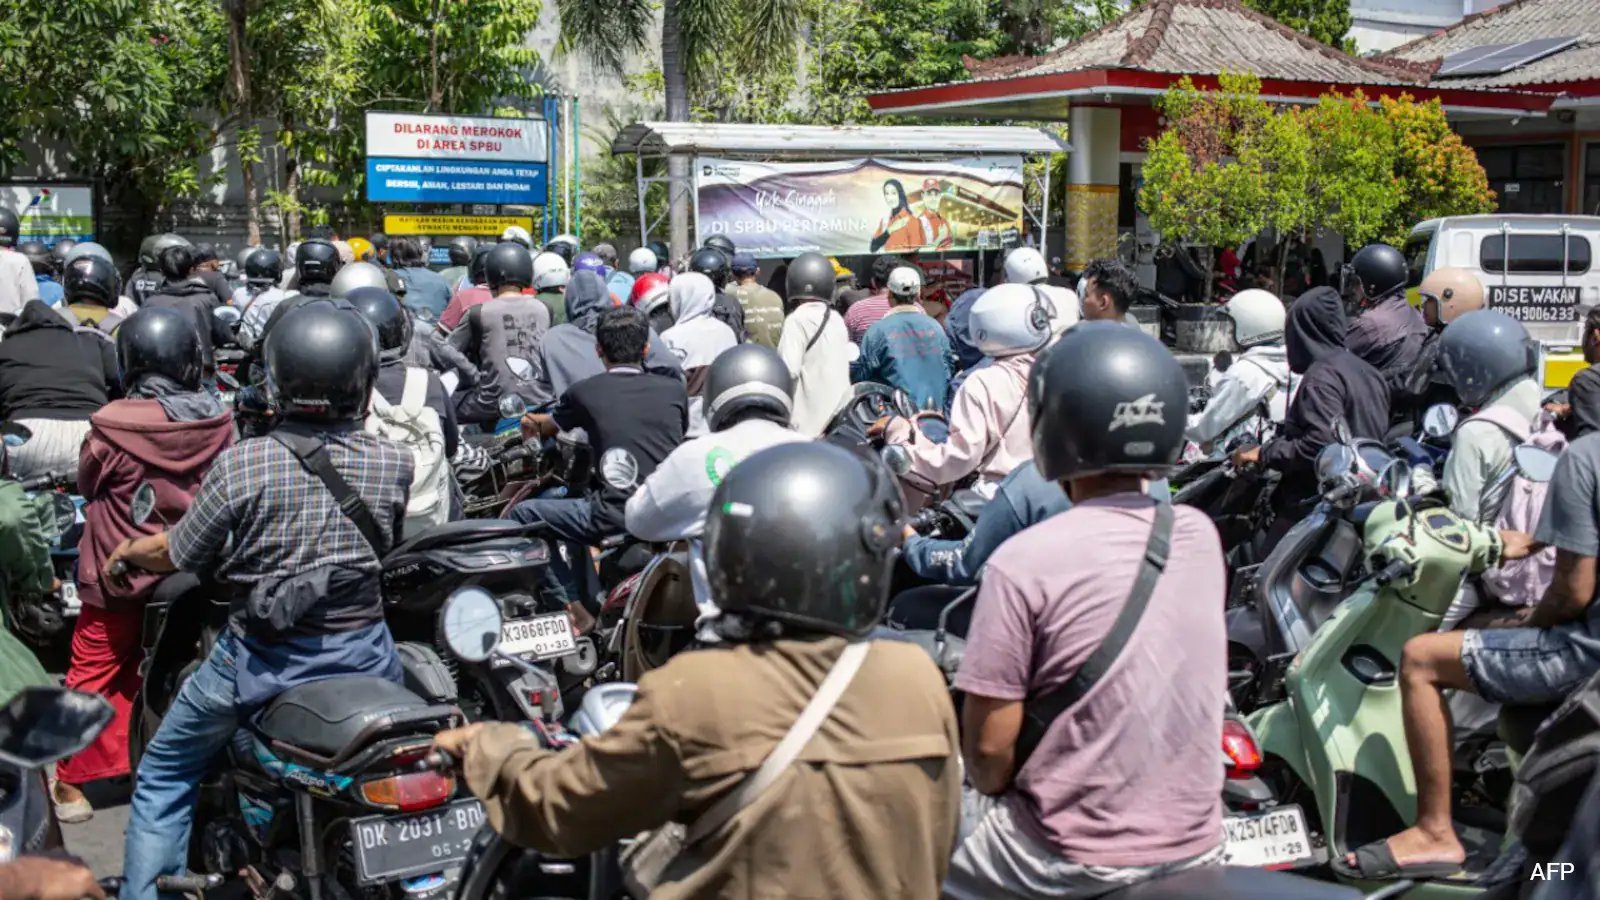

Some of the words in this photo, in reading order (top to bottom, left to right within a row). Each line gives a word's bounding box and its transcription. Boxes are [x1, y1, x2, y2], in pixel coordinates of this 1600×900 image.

[394, 123, 458, 136] DILARANG
[462, 126, 522, 139] MEROKOK
[417, 140, 430, 150] DI
[433, 140, 465, 151] AREA
[470, 141, 502, 152] SPBU
[436, 165, 490, 175] LINGKUNGAN
[492, 167, 514, 177] ANDA
[516, 169, 540, 178] TETAP
[451, 181, 485, 191] LESTARI
[486, 182, 503, 191] DAN
[711, 221, 729, 234] DI
[735, 220, 778, 234] SPBU
[783, 219, 869, 233] PERTAMINA
[362, 823, 388, 849] DK
[397, 814, 442, 842] 2031
